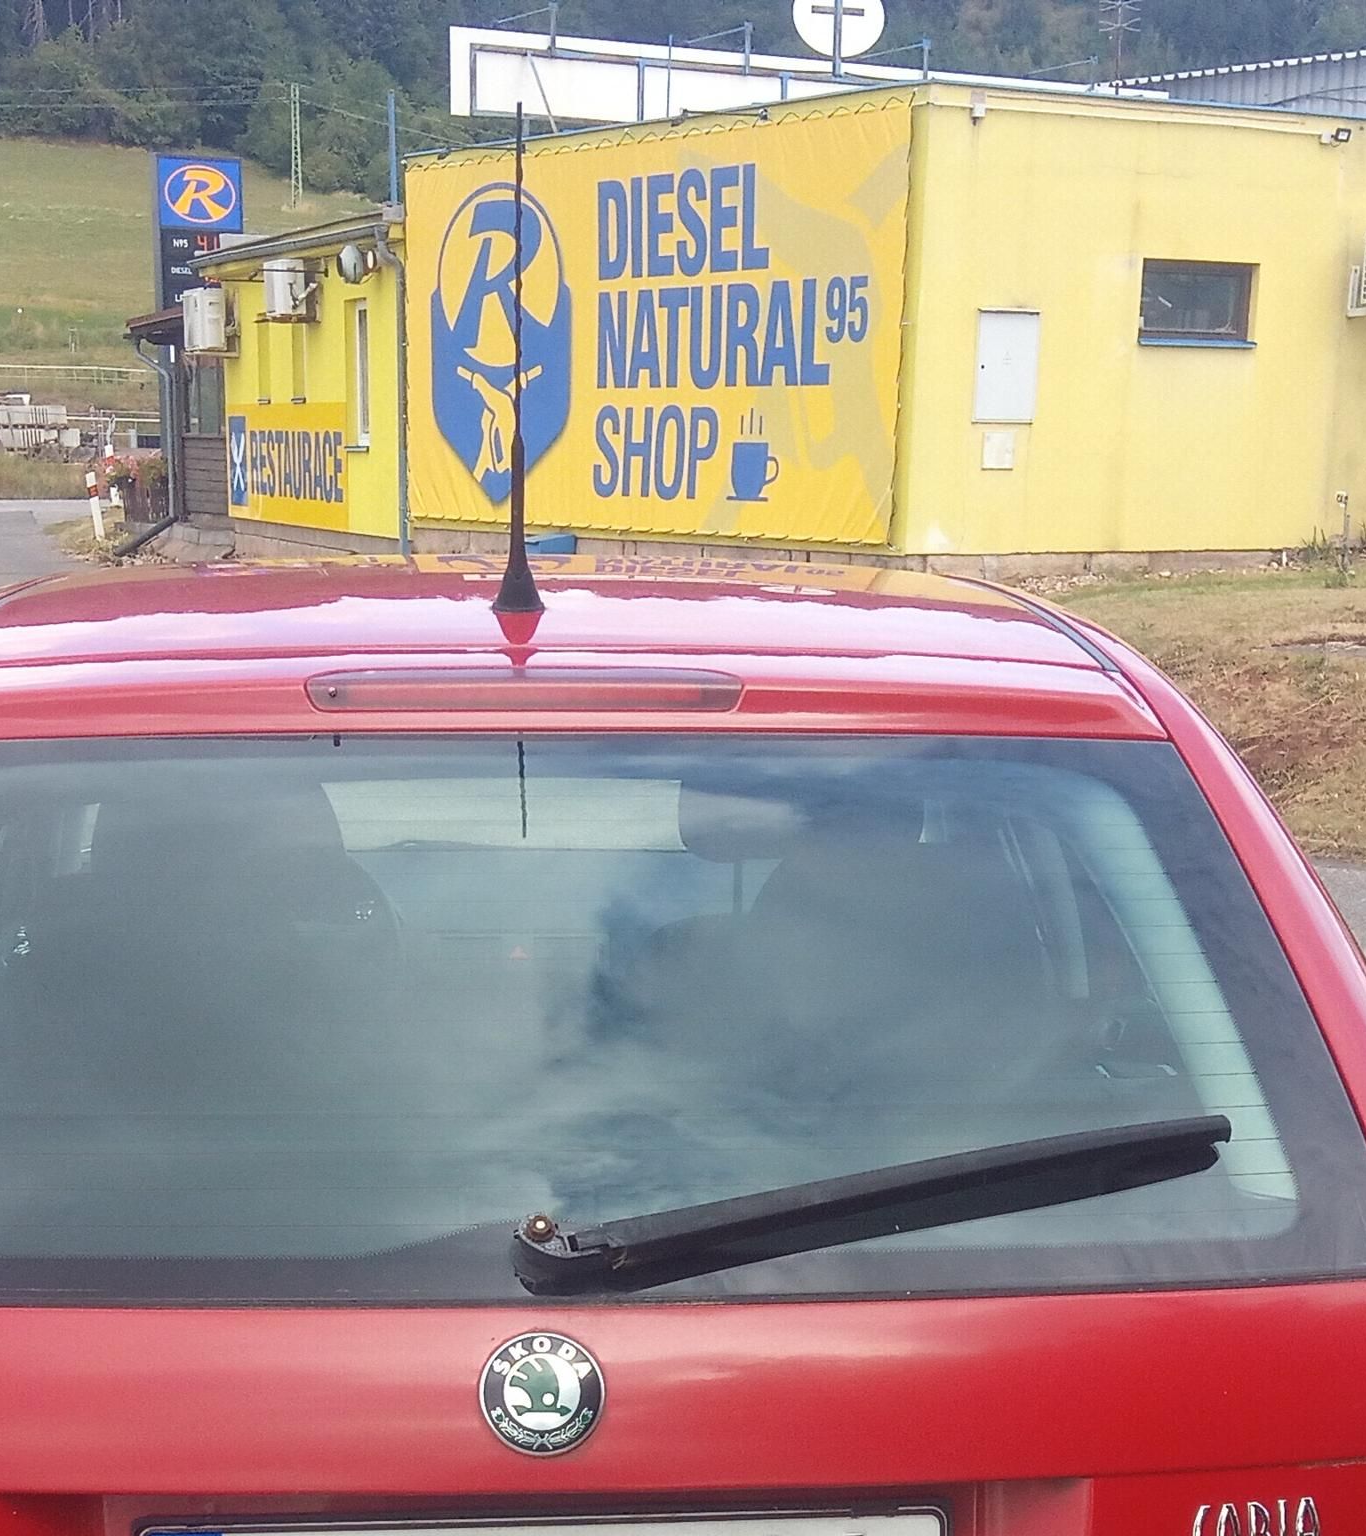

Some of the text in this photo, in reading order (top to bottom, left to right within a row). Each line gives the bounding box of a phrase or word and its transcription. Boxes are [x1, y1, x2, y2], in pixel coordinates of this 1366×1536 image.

[173, 167, 228, 222] R
[597, 163, 769, 280] DIESEL
[171, 267, 192, 275] DIESEL
[173, 238, 188, 248] N95
[597, 276, 869, 389] NATURAL 95
[251, 430, 344, 502] RESTAURACE
[593, 404, 720, 500] SHOP
